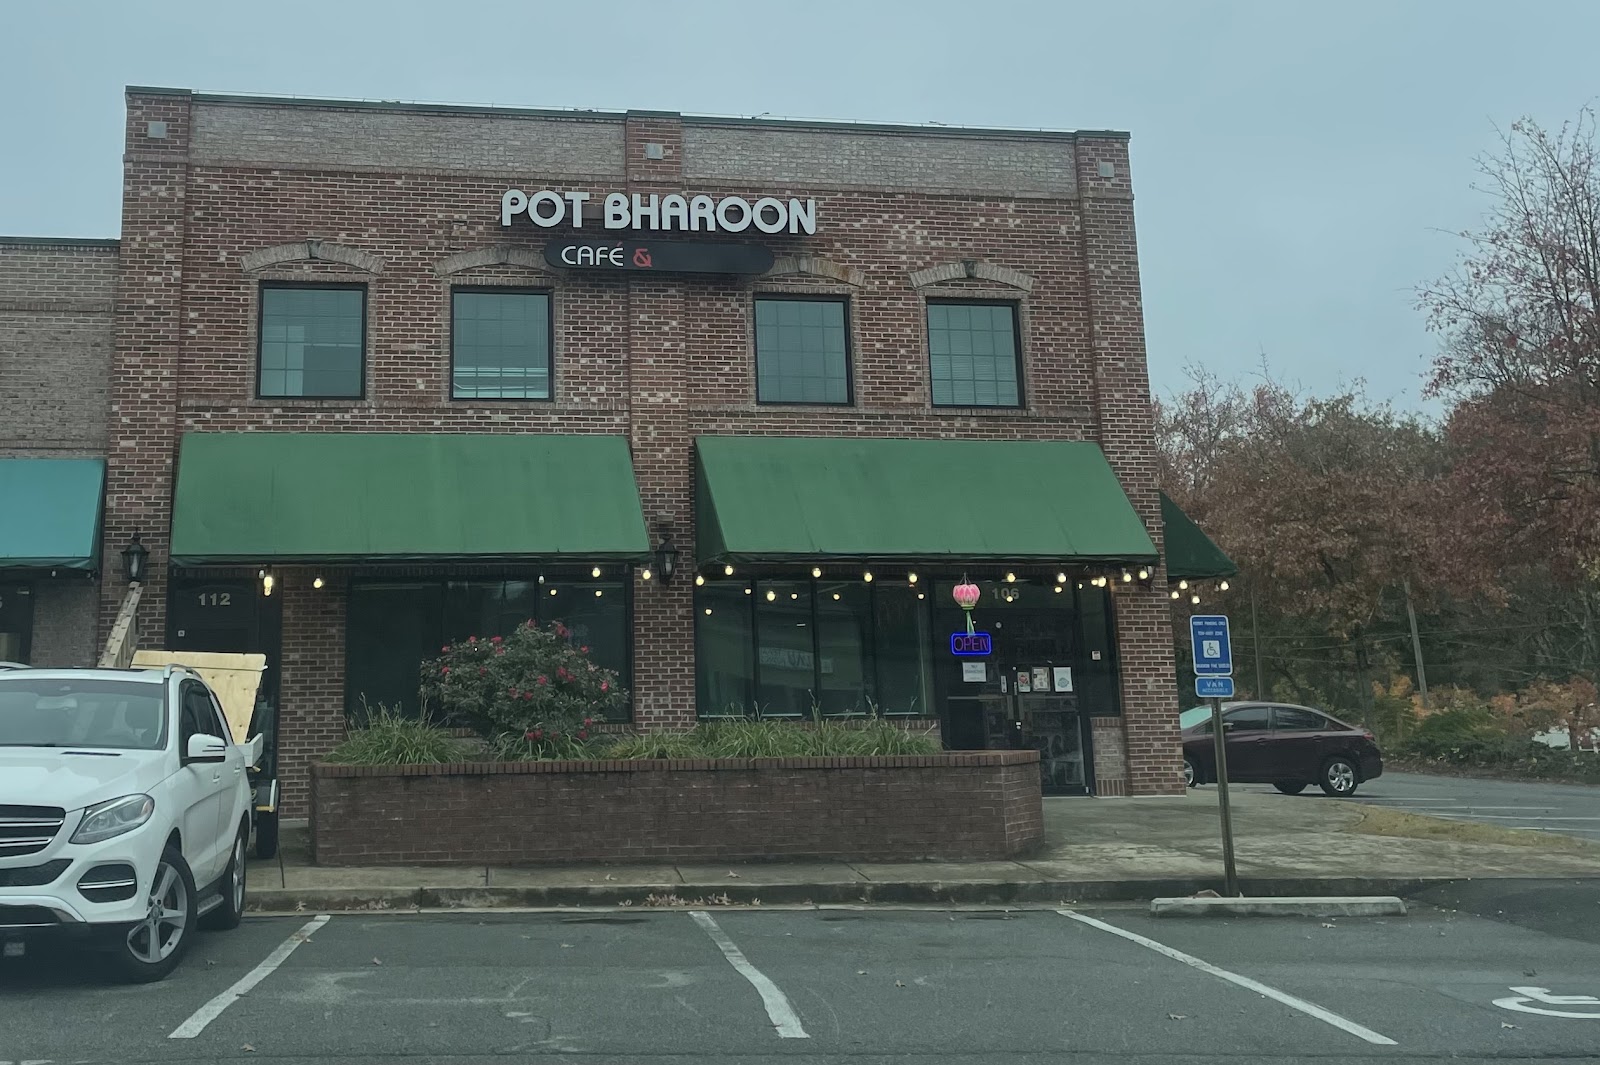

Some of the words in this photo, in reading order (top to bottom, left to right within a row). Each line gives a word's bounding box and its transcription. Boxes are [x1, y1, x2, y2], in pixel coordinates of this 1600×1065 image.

[501, 188, 590, 229] POT
[603, 192, 817, 236] BHAROON
[560, 241, 624, 267] CAFÉ
[632, 248, 652, 268] &
[198, 592, 231, 606] 112
[991, 587, 1020, 600] 106
[953, 636, 989, 651] OPEN
[1205, 680, 1224, 688] VAN
